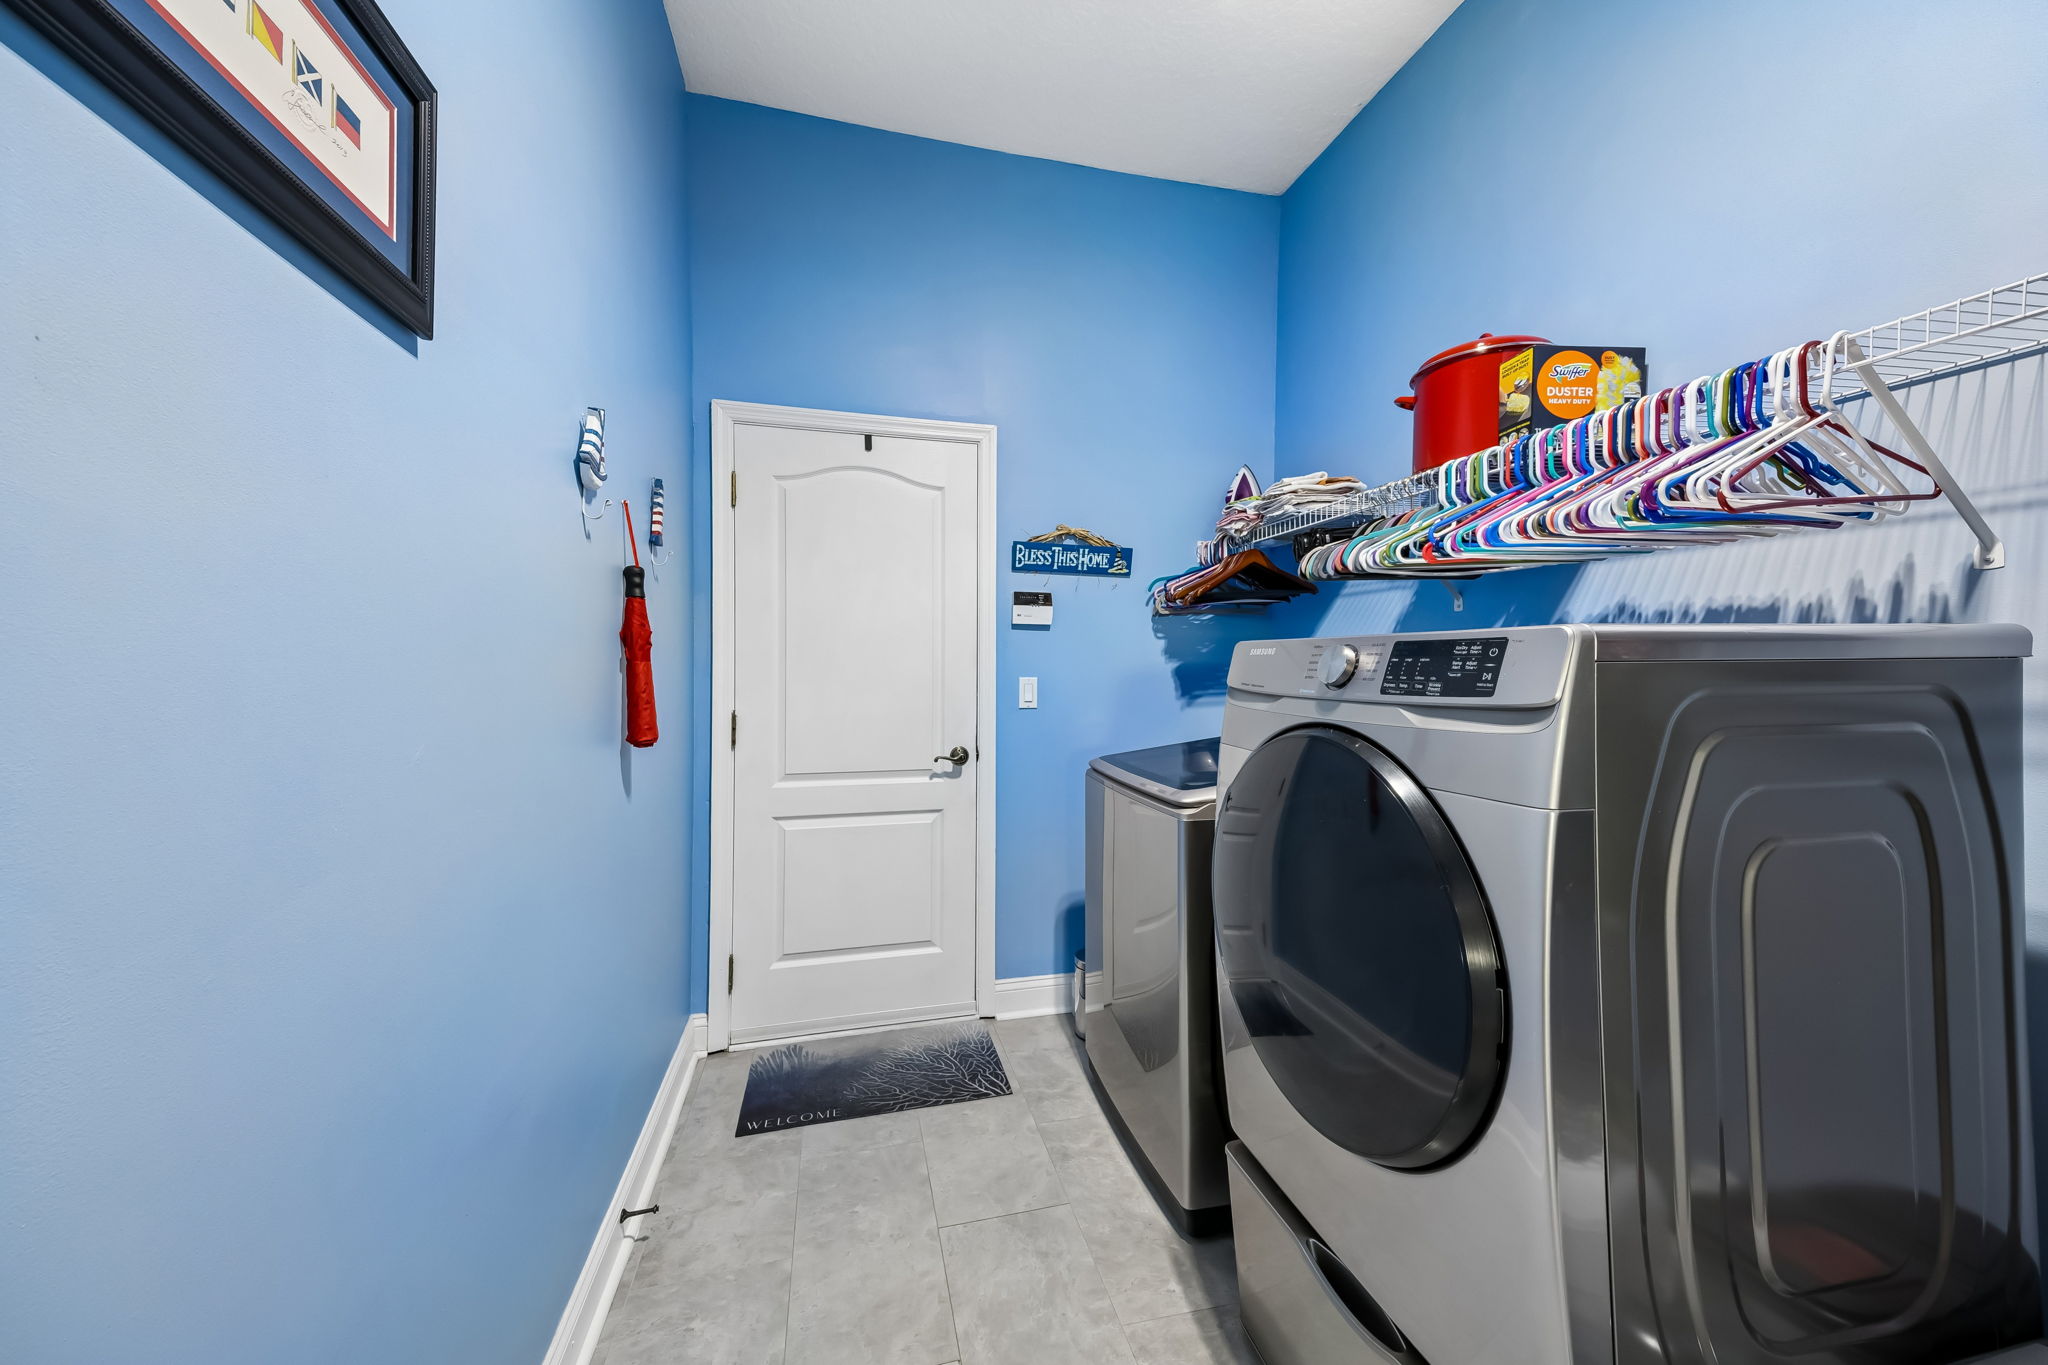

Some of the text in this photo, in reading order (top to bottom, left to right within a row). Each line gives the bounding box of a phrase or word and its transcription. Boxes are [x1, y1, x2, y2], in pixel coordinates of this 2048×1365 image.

[1549, 364, 1590, 380] Swiffer
[1546, 386, 1594, 397] DUSTER
[1015, 544, 1111, 571] BLESS THIS HOME
[1249, 647, 1277, 656] SAMSUNG
[747, 1108, 841, 1130] WELCOME
